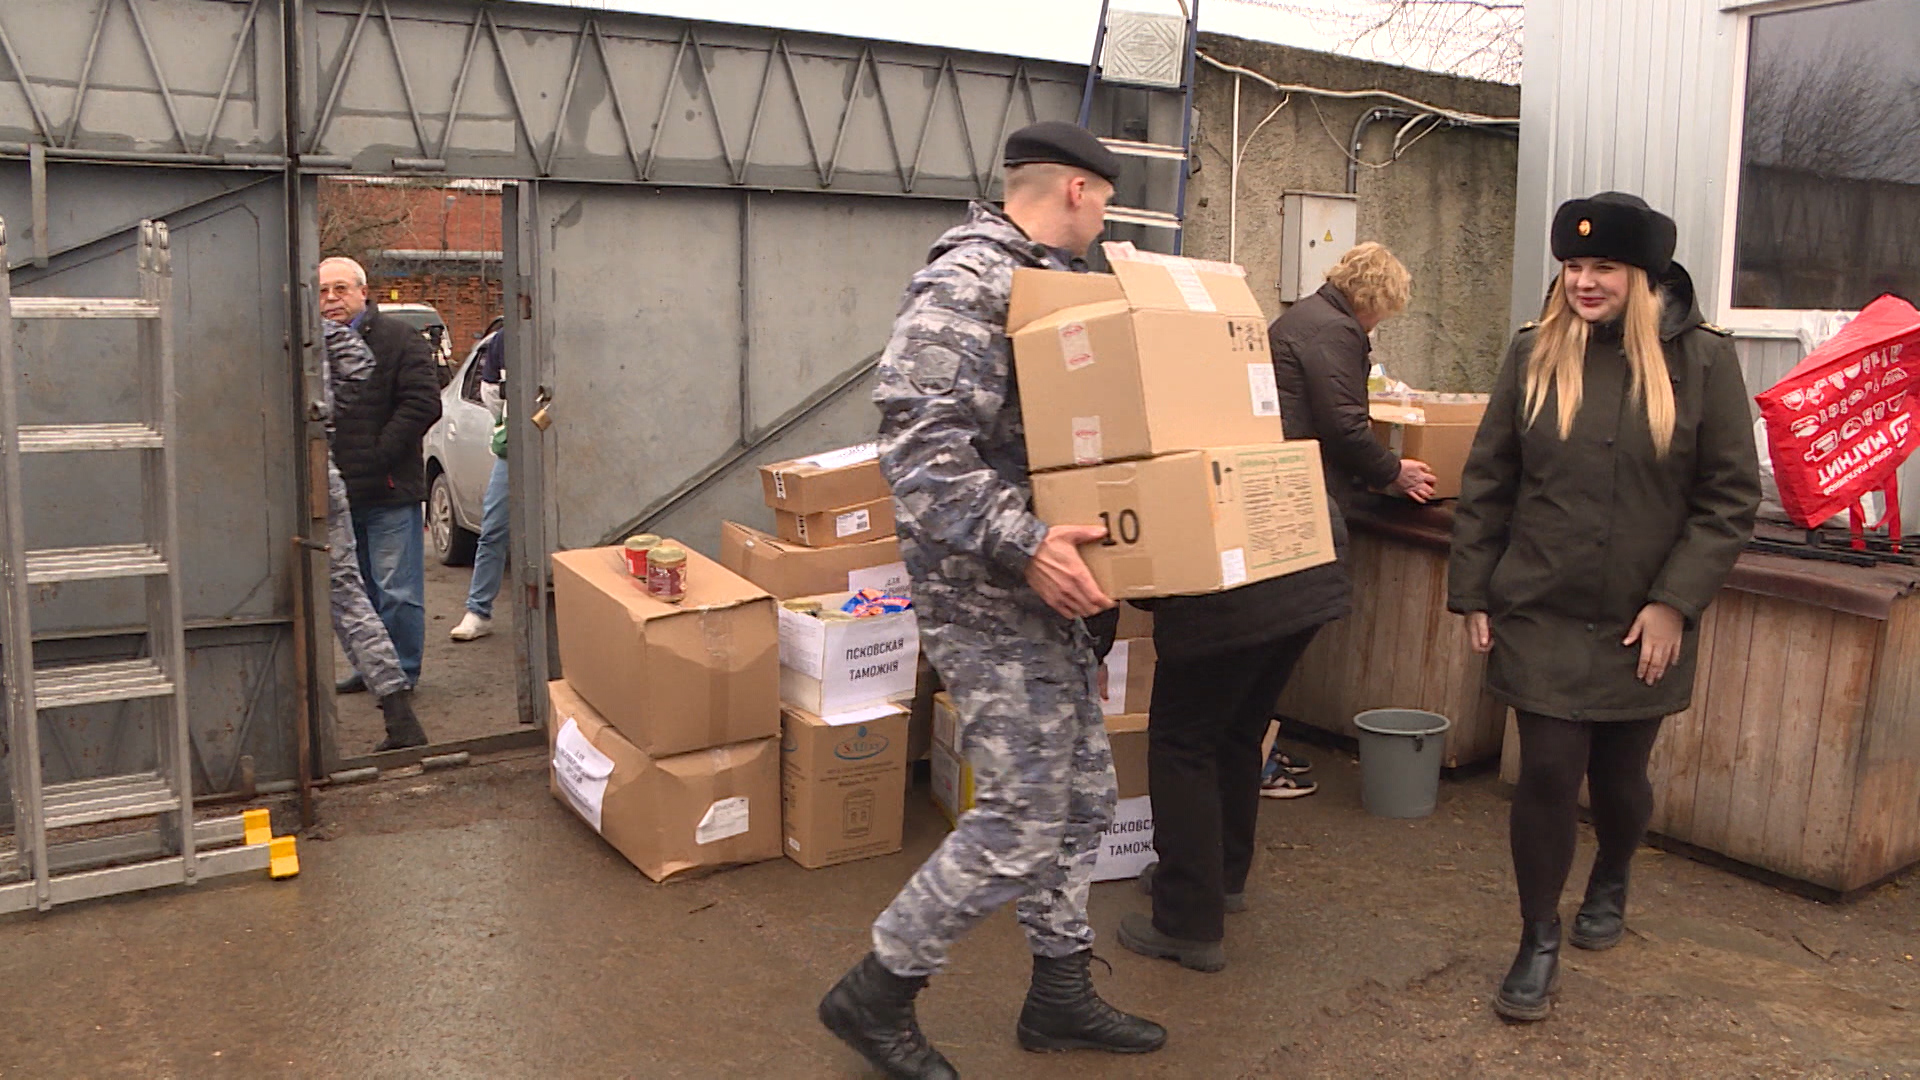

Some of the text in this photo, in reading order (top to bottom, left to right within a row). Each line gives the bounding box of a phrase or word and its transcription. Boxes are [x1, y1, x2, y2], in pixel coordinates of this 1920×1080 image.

[1818, 429, 1889, 486] МАГНИТ
[1098, 509, 1140, 547] 10
[846, 638, 905, 661] ПСКОВСКАЯ
[849, 660, 899, 681] ТАМОЖНЯ
[1104, 819, 1154, 836] СКОВС
